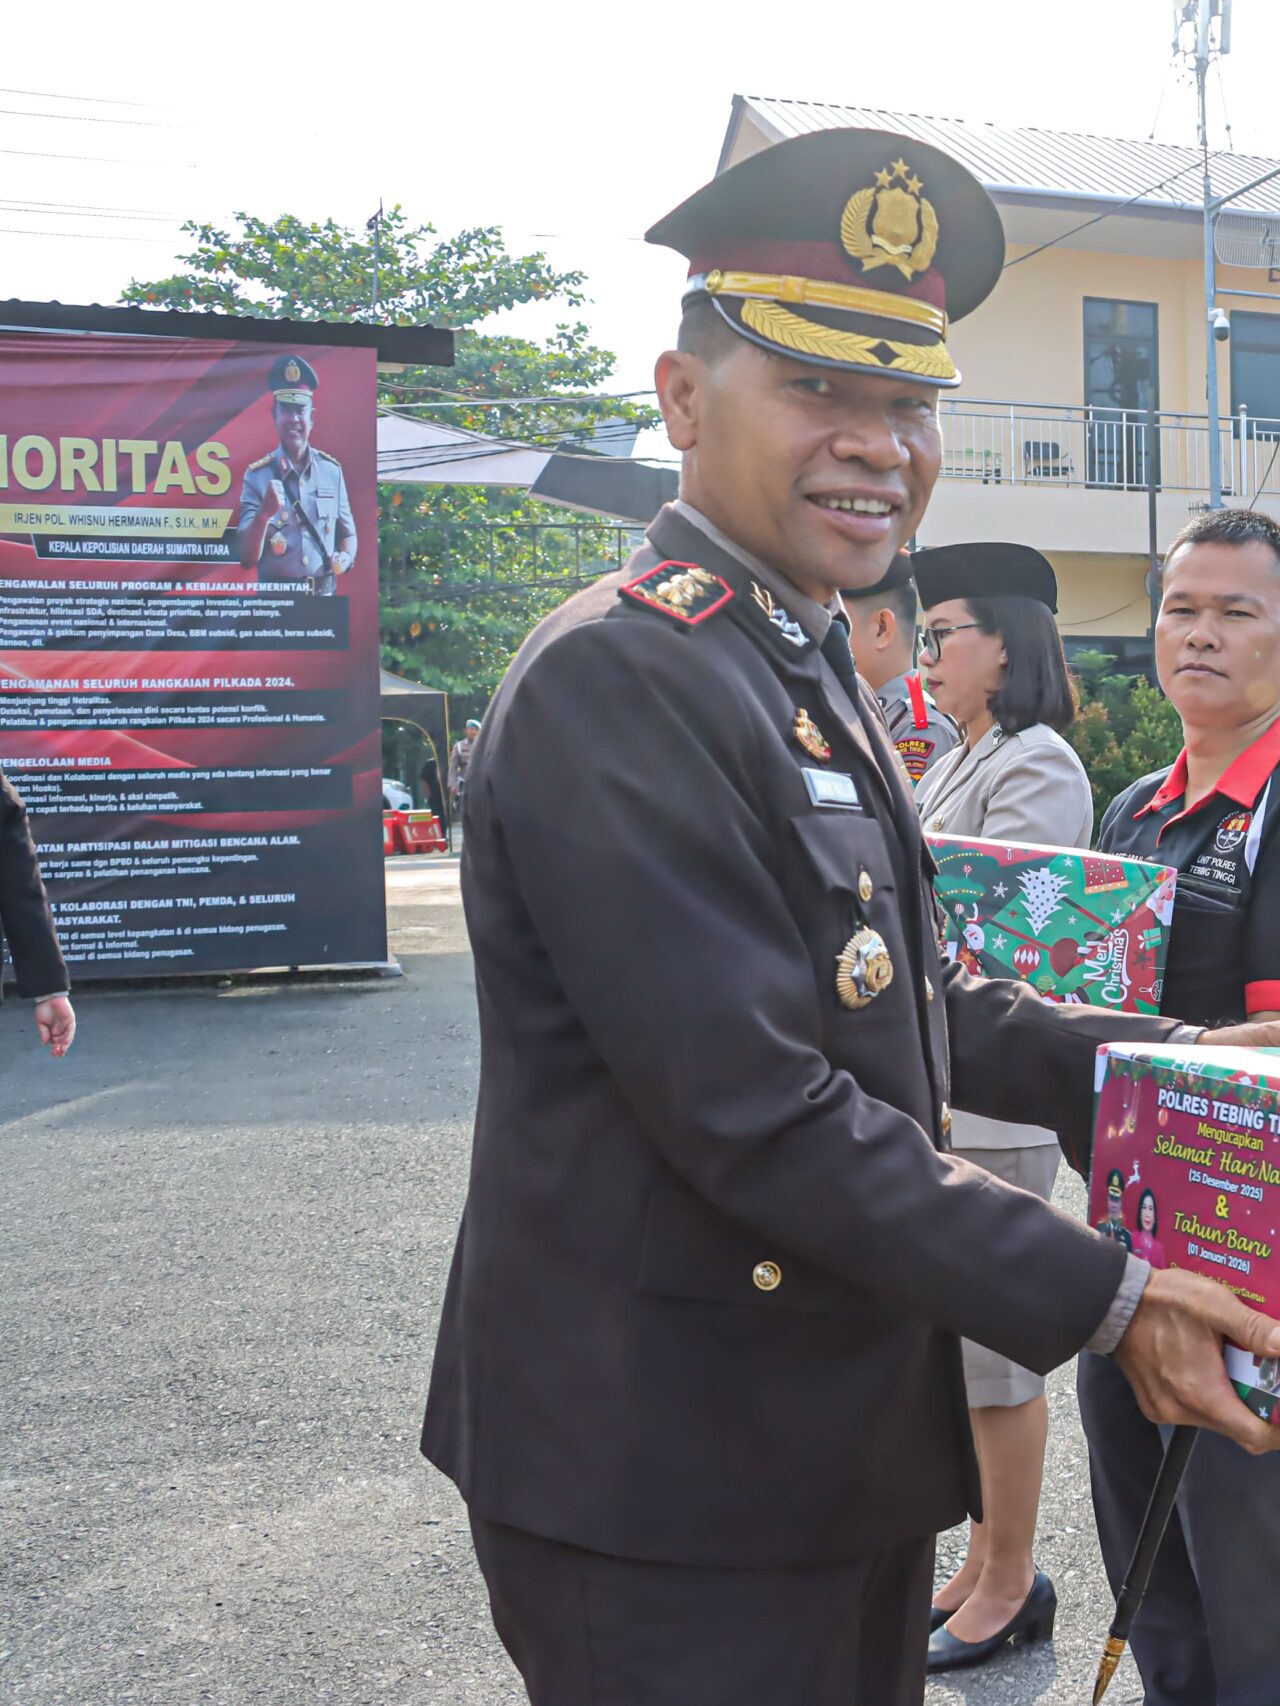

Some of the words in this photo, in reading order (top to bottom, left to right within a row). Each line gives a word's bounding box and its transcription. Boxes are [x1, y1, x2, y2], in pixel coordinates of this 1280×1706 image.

[14, 512, 42, 524] IRJEN
[45, 514, 65, 526] POL.
[69, 515, 106, 526] WHISNU
[109, 516, 162, 528] HERMAWAN
[202, 518, 221, 528] M.H.
[50, 541, 80, 553] KEPALA
[83, 542, 130, 554] KEPOLISIAN
[132, 542, 164, 555] DAERAH
[166, 543, 202, 556] SUMATRA
[204, 544, 230, 556] UTARA
[69, 580, 118, 590] SELURUH
[122, 582, 172, 591] PROGRAM
[175, 582, 182, 591] &
[186, 582, 243, 591] KEBIJAKAN
[246, 582, 314, 592] PEMERINTAH.
[86, 608, 105, 616] SDA,
[220, 610, 251, 618] program
[253, 610, 281, 618] lainnya.
[167, 630, 187, 638] Desa,
[0, 679, 78, 689] ENGAMANAN
[83, 679, 138, 688] SELURUH
[142, 678, 210, 688] RANGKAIAN
[214, 678, 262, 688] PILKADA
[265, 678, 295, 687] 2024.
[48, 697, 70, 706] tinggi
[0, 708, 32, 716] Deteksi,
[34, 708, 74, 716] pemetaan,
[92, 707, 142, 716] penyelesaian
[144, 706, 159, 714] dini
[212, 706, 239, 714] potensi
[0, 718, 38, 726] Pelatihan
[168, 716, 196, 724] Pilkada
[242, 714, 284, 722] Profesional
[292, 714, 326, 722] Humanis.
[896, 741, 926, 749] OLRES
[78, 757, 111, 766] MEDIA
[48, 774, 62, 782] dan
[64, 774, 106, 782] Kolaborasi
[108, 774, 136, 782] dengan
[192, 772, 210, 780] yang
[256, 768, 290, 776] informasi
[292, 770, 308, 778] yang
[310, 768, 331, 776] benar
[48, 794, 88, 802] informasi,
[36, 806, 58, 814] cepat
[59, 805, 94, 814] terhadap
[96, 804, 118, 812] berita
[158, 802, 203, 812] masyarakat.
[68, 842, 130, 852] PARTISIPASI
[134, 840, 168, 850] DALAM
[172, 838, 217, 848] MITIGASI
[220, 837, 268, 847] BENCANA
[270, 836, 300, 846] ALAM.
[50, 860, 68, 869] kerja
[94, 869, 128, 878] pelatihan
[60, 901, 128, 912] KOLABORASI
[130, 899, 172, 908] DENGAN
[176, 898, 196, 908] TNI,
[199, 896, 236, 906] PEMDA,
[239, 896, 246, 904] &
[249, 894, 296, 904] SELURUH
[1101, 928, 1132, 1003] Christmas
[1158, 1088, 1209, 1116] POLRES
[1212, 1100, 1264, 1130] TEBING
[1197, 1122, 1264, 1152] Mengucapkan
[1154, 1134, 1216, 1166] Selamat
[1220, 1152, 1258, 1178] Hari
[1188, 1168, 1201, 1182] (25
[1202, 1174, 1239, 1192] Desember
[1240, 1184, 1264, 1202] 2025)
[1216, 1194, 1229, 1218] &
[1174, 1212, 1225, 1244] Tahun
[1226, 1229, 1272, 1258] Baru
[1188, 1242, 1198, 1256] (01
[1200, 1247, 1227, 1265] Januari
[1228, 1256, 1250, 1274] 2026)
